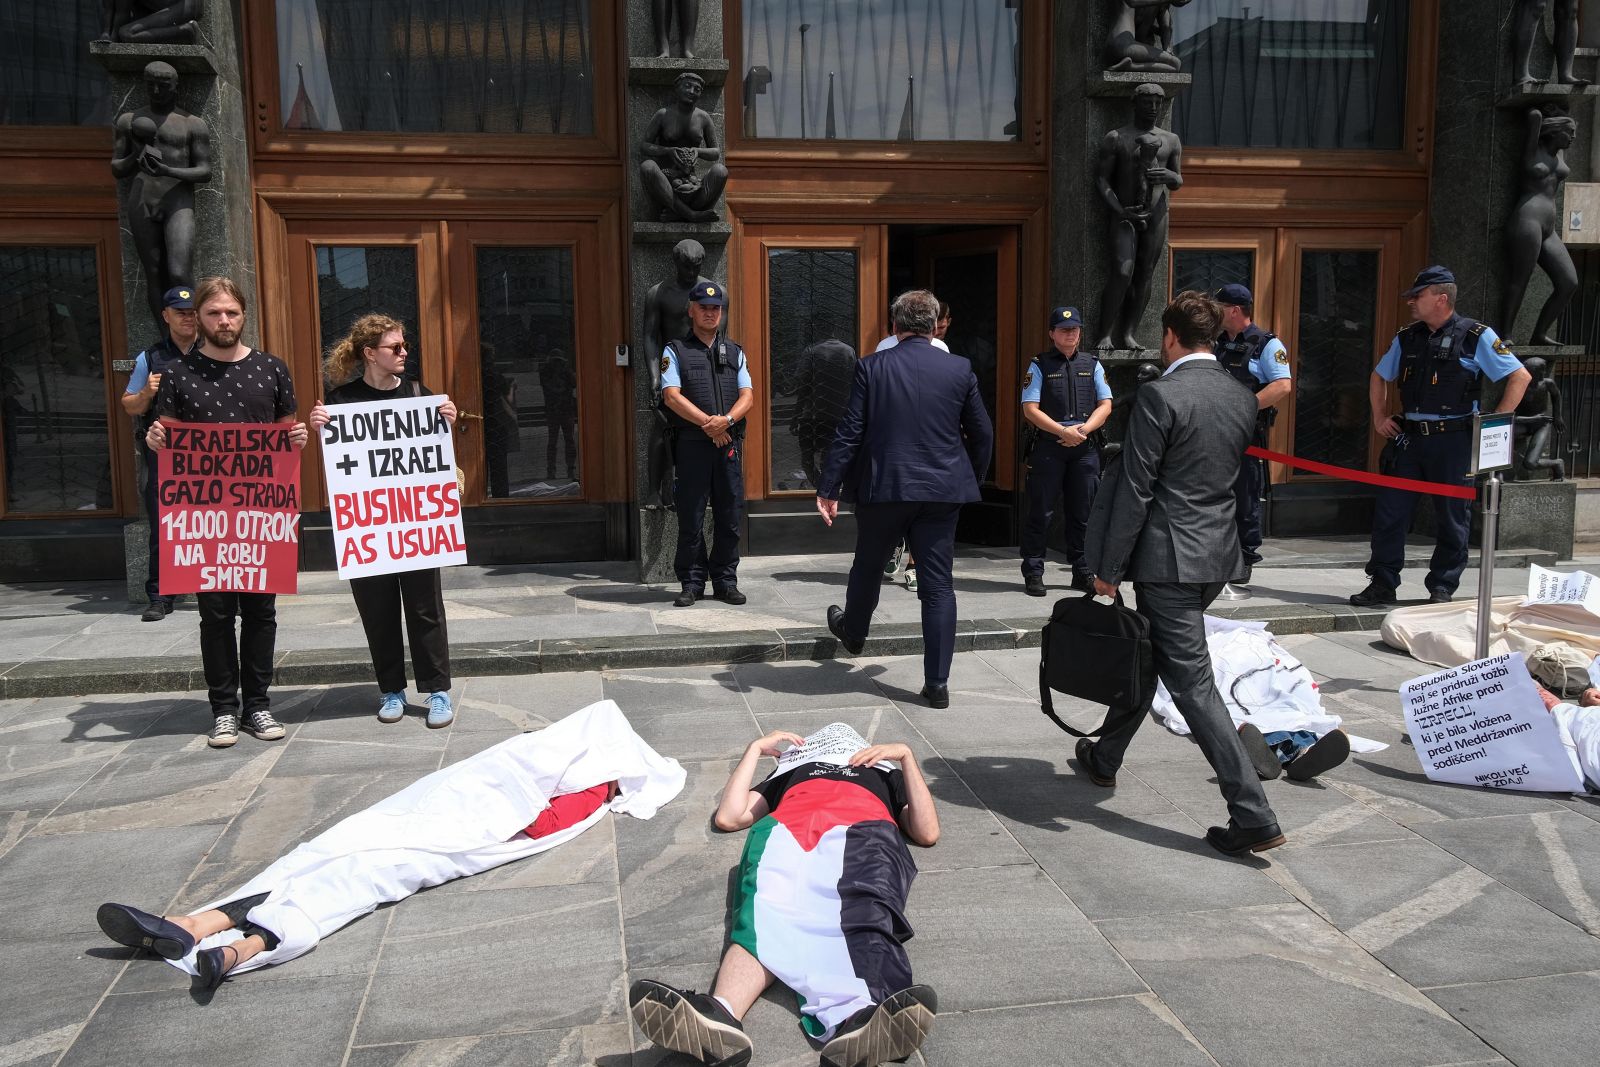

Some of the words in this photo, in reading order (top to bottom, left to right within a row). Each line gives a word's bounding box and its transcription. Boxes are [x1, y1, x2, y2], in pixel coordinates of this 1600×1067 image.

[164, 427, 293, 453] IZRAELSKA
[323, 406, 449, 445] SLOVENIJA
[172, 452, 274, 477] BLOKADA
[367, 444, 451, 478] IZRAEL
[160, 479, 223, 507] GAZO
[229, 482, 298, 509] STRADA
[333, 481, 460, 531] BUSINESS
[161, 510, 229, 541] 14.000
[236, 510, 301, 543] OTROK
[174, 543, 206, 567] NA
[216, 542, 267, 566] ROBU
[341, 533, 378, 568] AS
[387, 523, 467, 560] USUAL
[200, 566, 268, 591] SMRTI
[1408, 670, 1458, 693] Republika
[1461, 653, 1511, 675] Slovenija
[1410, 693, 1426, 706] naj
[1427, 688, 1438, 699] se
[1441, 675, 1480, 696] pridruži
[1481, 665, 1510, 681] tožbi
[1412, 701, 1440, 717] Južne
[1442, 690, 1474, 708] Afrike
[1476, 681, 1504, 699] proti
[1420, 732, 1432, 744] ki
[1434, 729, 1445, 743] je
[1446, 723, 1468, 738] bila
[1469, 711, 1512, 731] vložena
[1427, 744, 1453, 759] pred
[1454, 720, 1532, 751] Meddržavnim
[1433, 747, 1488, 770] sodiščem!
[1474, 770, 1508, 783] NIKOLI
[1508, 763, 1530, 777] VEČ
[1493, 777, 1524, 788] ZDAJ!
